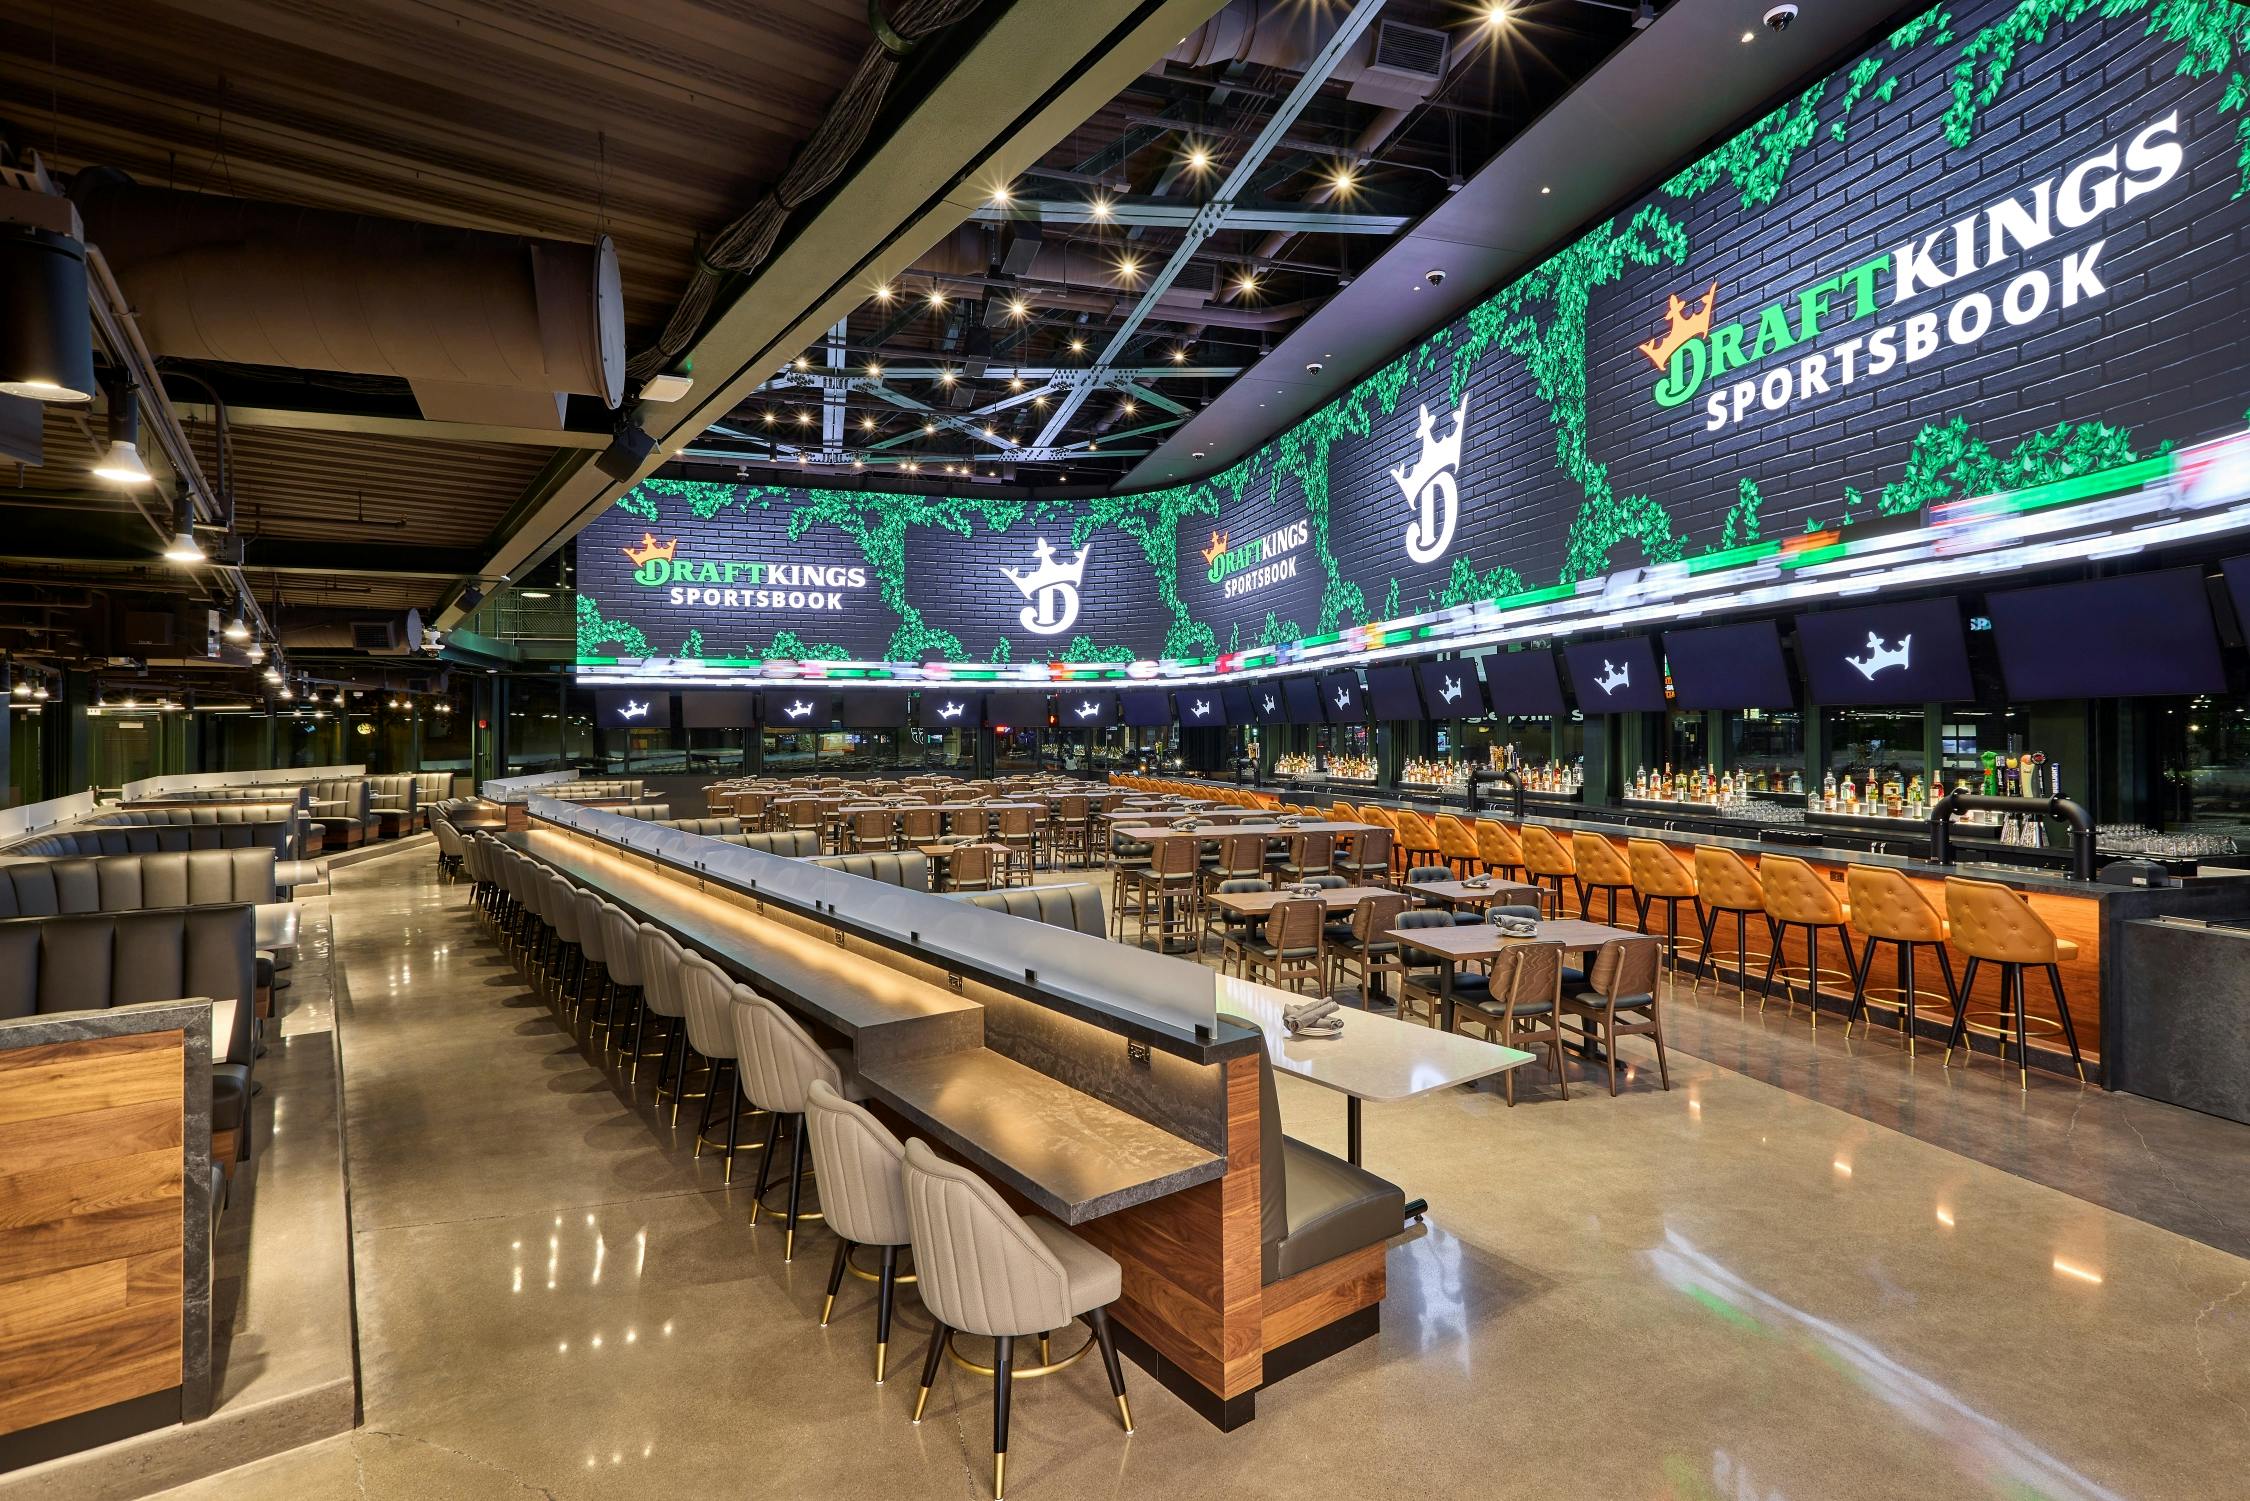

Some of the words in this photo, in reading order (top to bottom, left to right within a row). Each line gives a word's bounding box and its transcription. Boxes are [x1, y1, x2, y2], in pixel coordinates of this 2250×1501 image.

[1654, 109, 2184, 407] DRAFTKINGS
[1707, 239, 2107, 431] SPORTSBOOK
[633, 558, 867, 588] DRAFTKINGS
[1207, 519, 1308, 583] DRAFTKINGS
[1224, 556, 1297, 599] SPORTSBOOK
[670, 588, 843, 610] SPORTSBOOK
